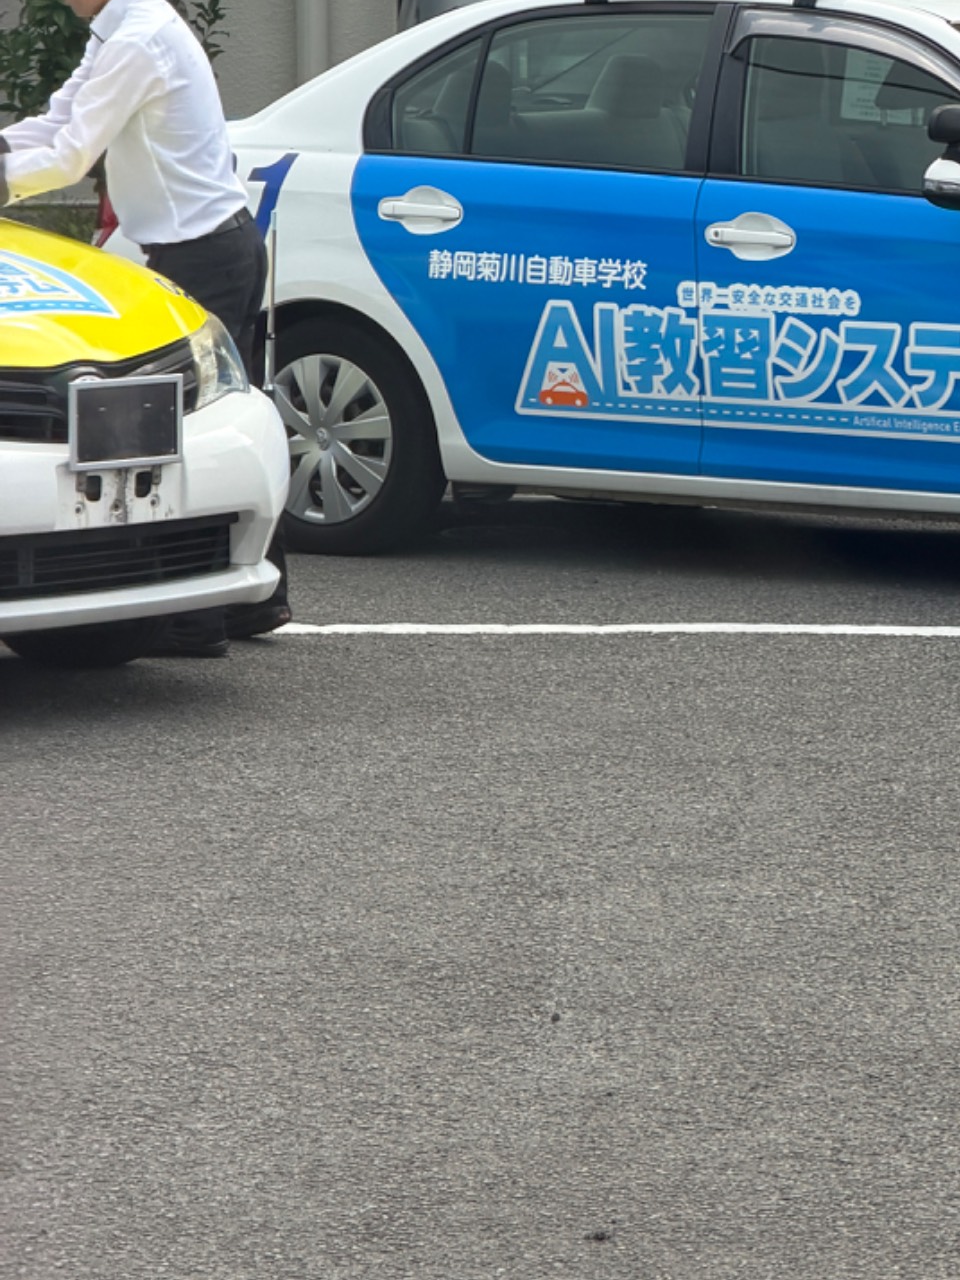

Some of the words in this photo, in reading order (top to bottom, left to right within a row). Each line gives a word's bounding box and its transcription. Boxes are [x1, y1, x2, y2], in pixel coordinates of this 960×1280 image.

[428, 249, 647, 290] 静岡菊川自動車学校
[682, 287, 856, 310] 世界一安全な交通社会を
[894, 417, 950, 433] Intelligence
